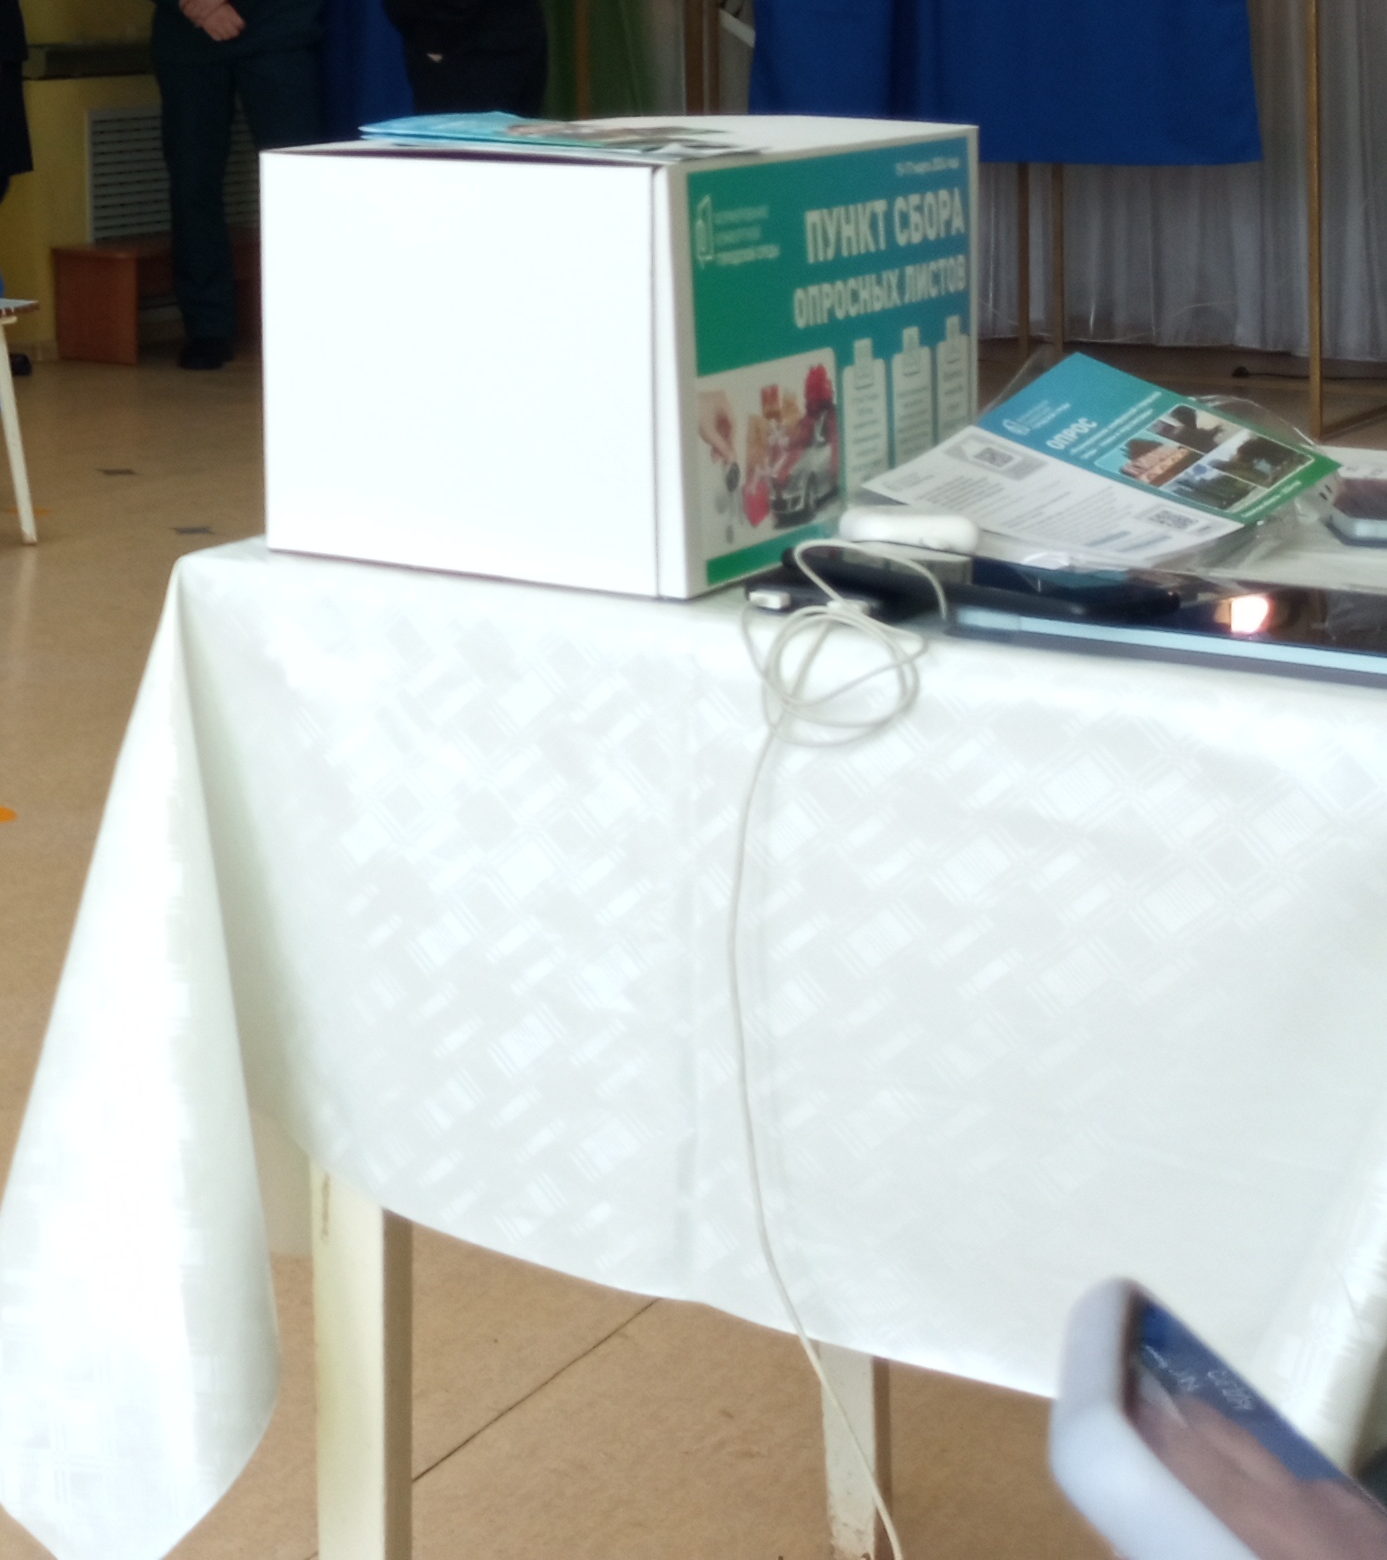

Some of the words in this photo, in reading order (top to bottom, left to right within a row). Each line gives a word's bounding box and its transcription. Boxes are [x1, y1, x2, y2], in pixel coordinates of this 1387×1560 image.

[804, 198, 888, 265] ПУНКТ
[893, 187, 966, 248] СБОРА
[793, 268, 901, 330] ОПРОСНЫХ
[904, 254, 967, 304] ЛИСТОВ
[1045, 417, 1099, 451] ОПРОС
